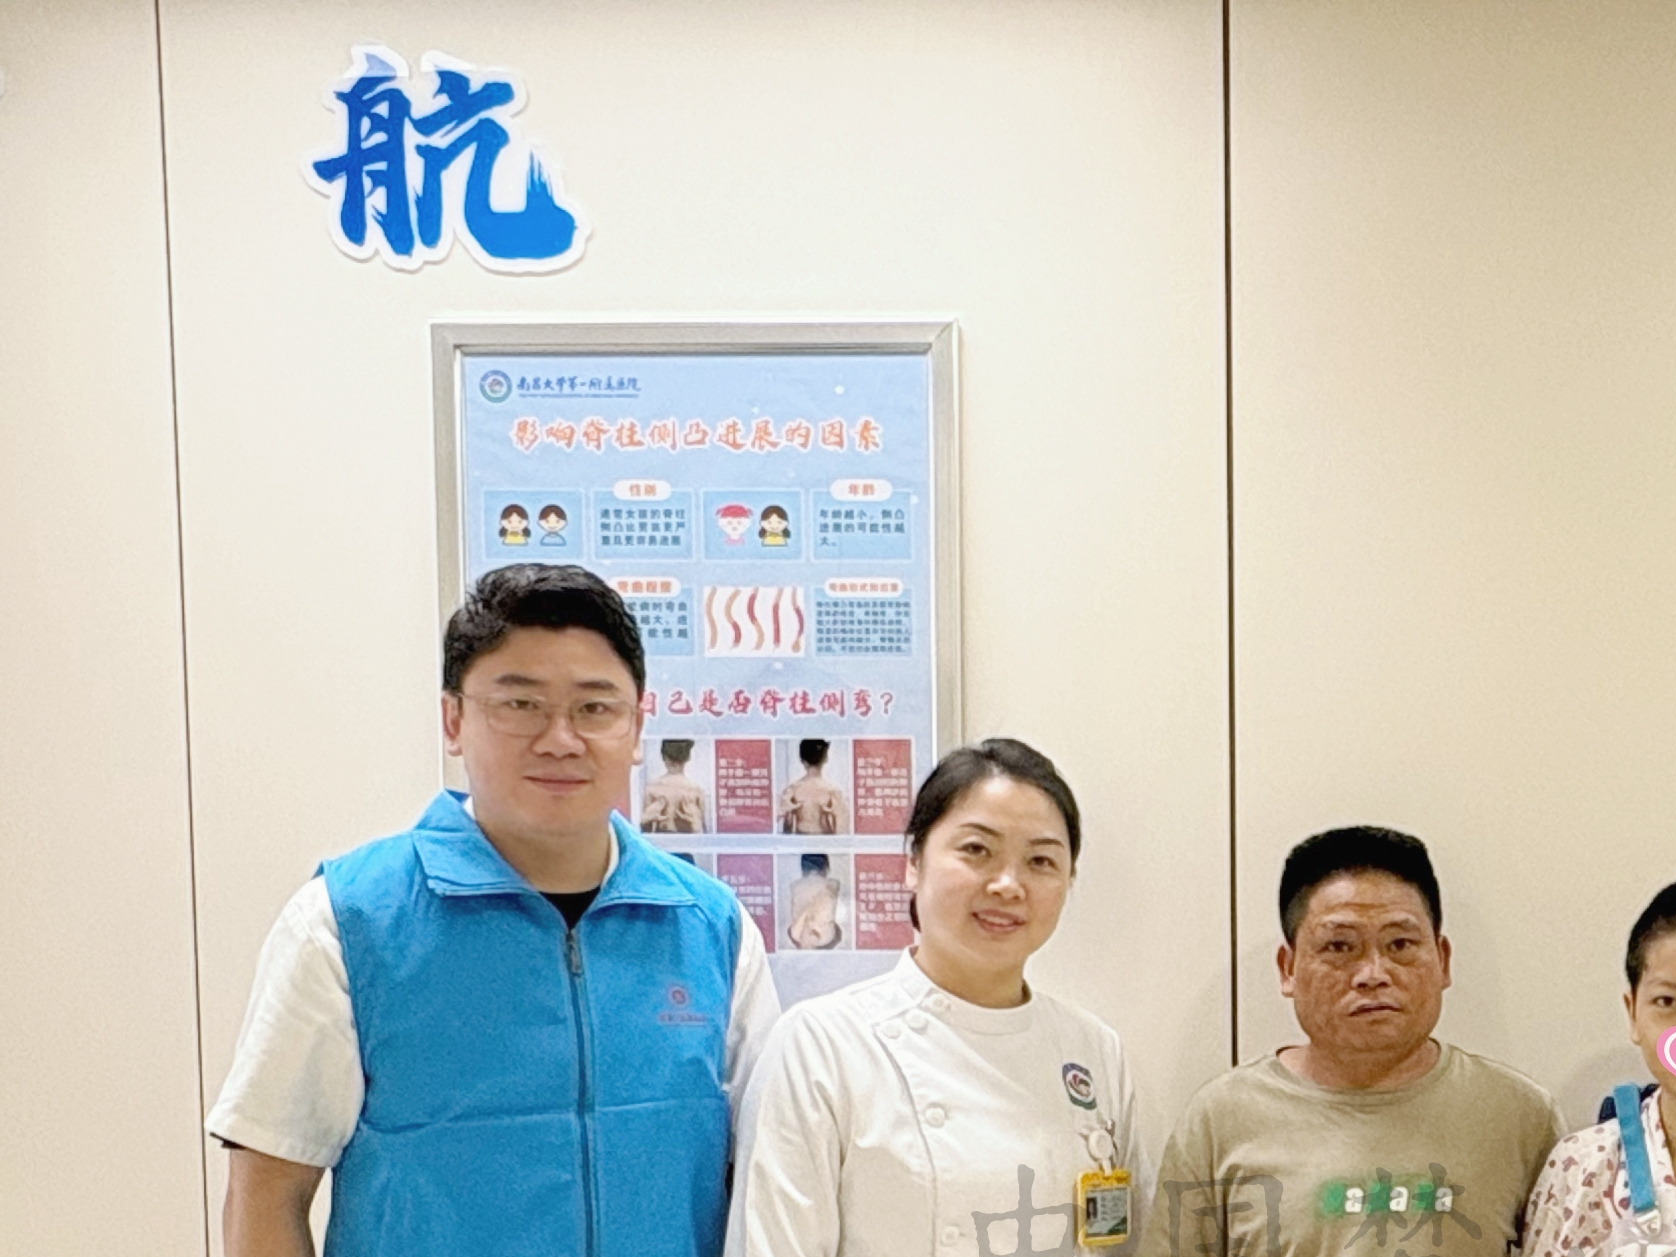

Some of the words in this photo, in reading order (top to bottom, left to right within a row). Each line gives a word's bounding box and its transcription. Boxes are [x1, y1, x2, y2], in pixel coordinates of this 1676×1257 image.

[310, 50, 577, 260] 航
[512, 418, 881, 452] 影响脊柱侧凸进展的因素
